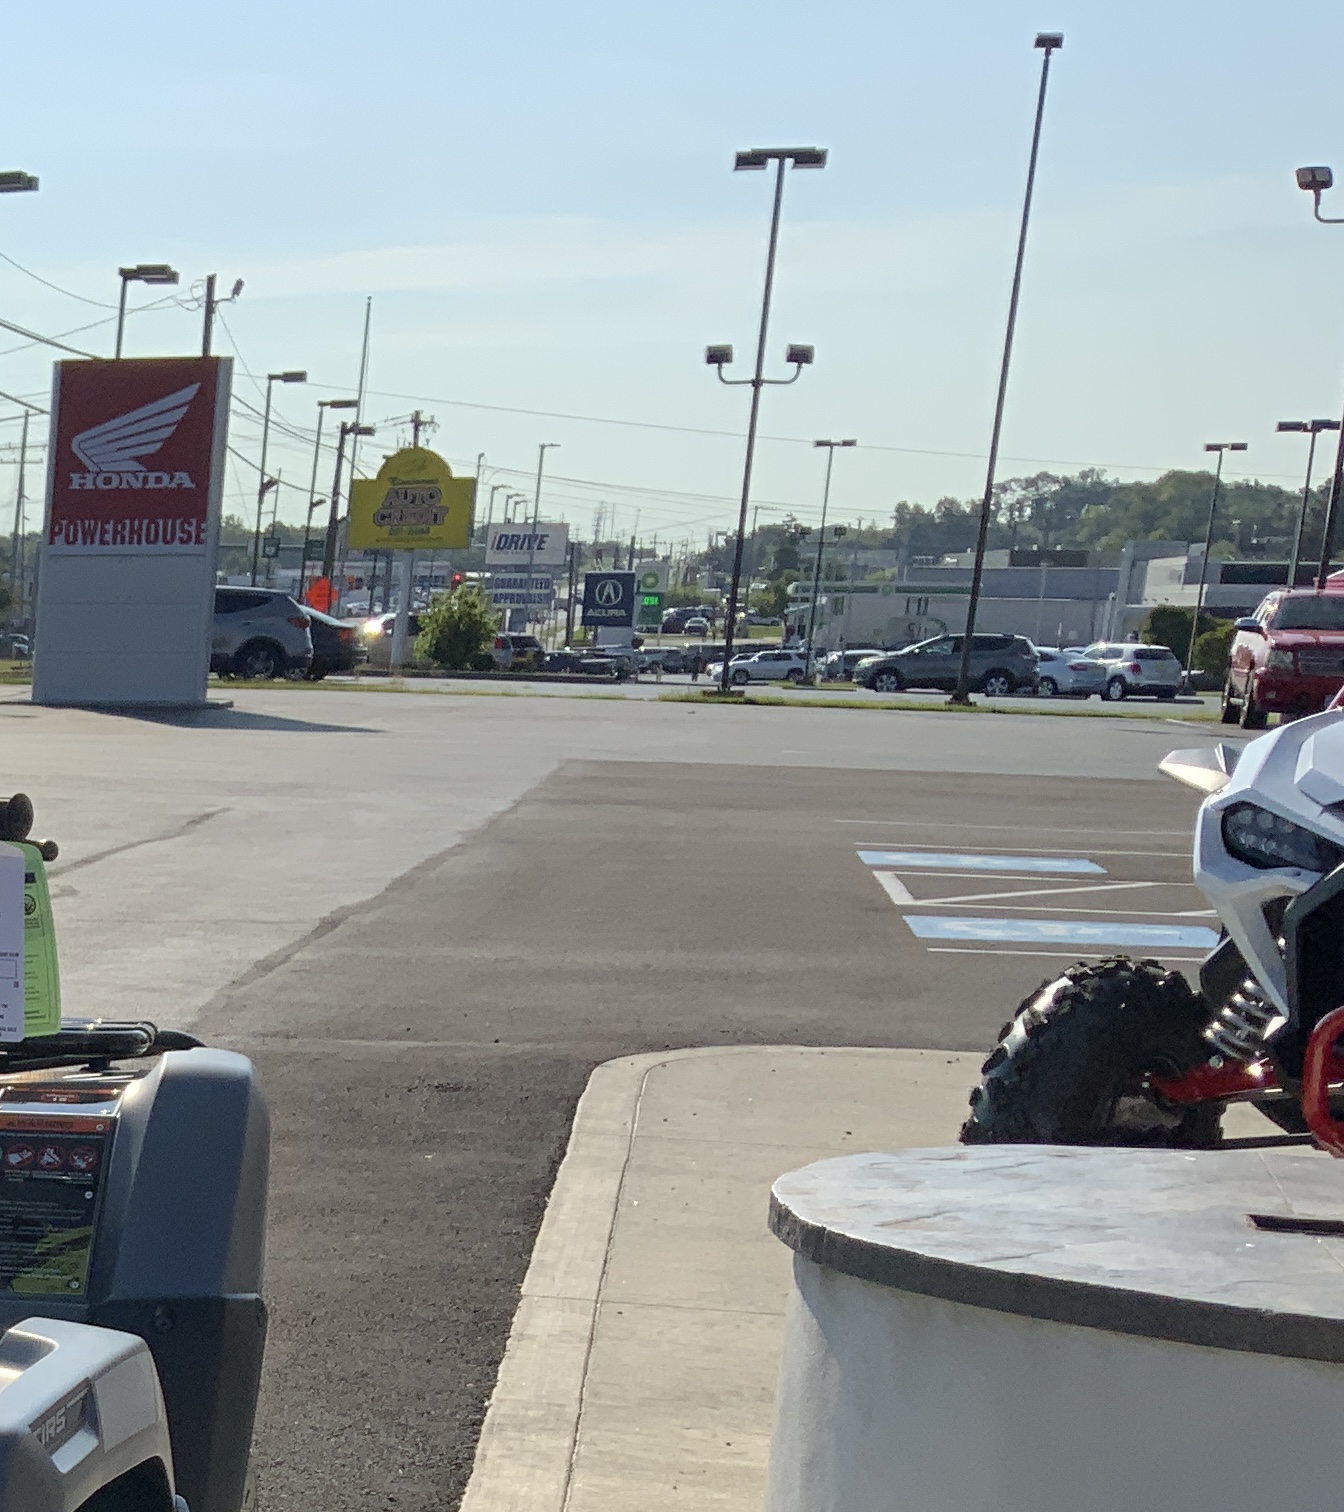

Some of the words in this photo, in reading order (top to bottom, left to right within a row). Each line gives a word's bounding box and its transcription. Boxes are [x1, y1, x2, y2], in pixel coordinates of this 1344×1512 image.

[70, 471, 196, 490] HONDA
[382, 486, 442, 507] AUTO
[373, 506, 449, 527] CREDIT
[48, 519, 207, 545] POWERHOUSE
